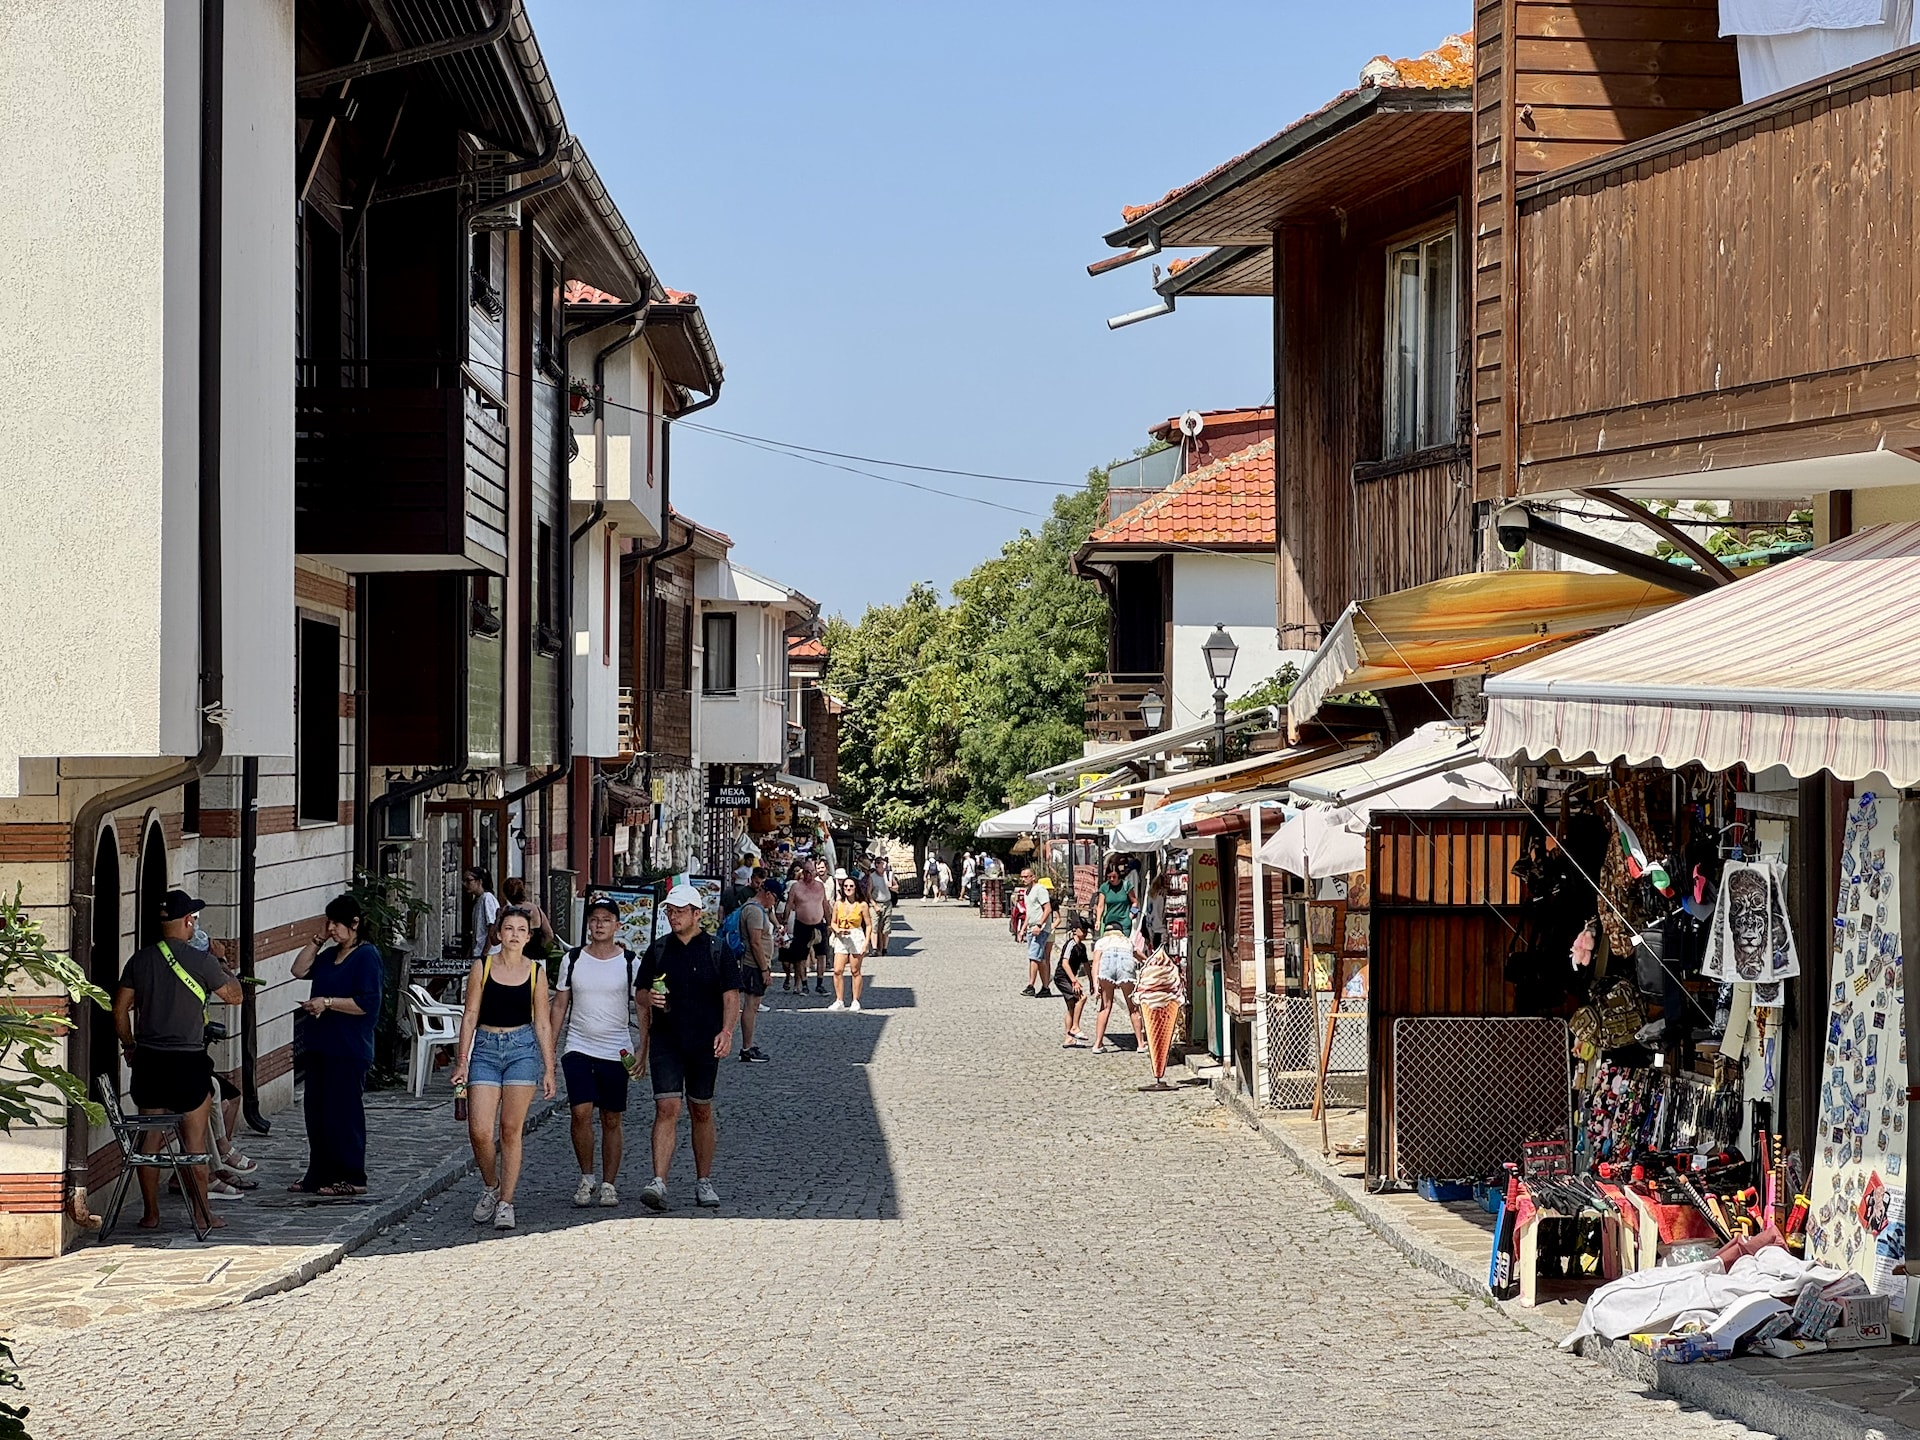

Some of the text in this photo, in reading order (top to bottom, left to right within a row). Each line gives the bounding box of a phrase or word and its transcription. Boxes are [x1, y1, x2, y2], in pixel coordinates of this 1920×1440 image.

[719, 788, 746, 796] МЕХА
[714, 796, 751, 806] ГРЕЦИЯ
[1198, 853, 1217, 867] Eis
[1860, 1325, 1881, 1337] Dole
